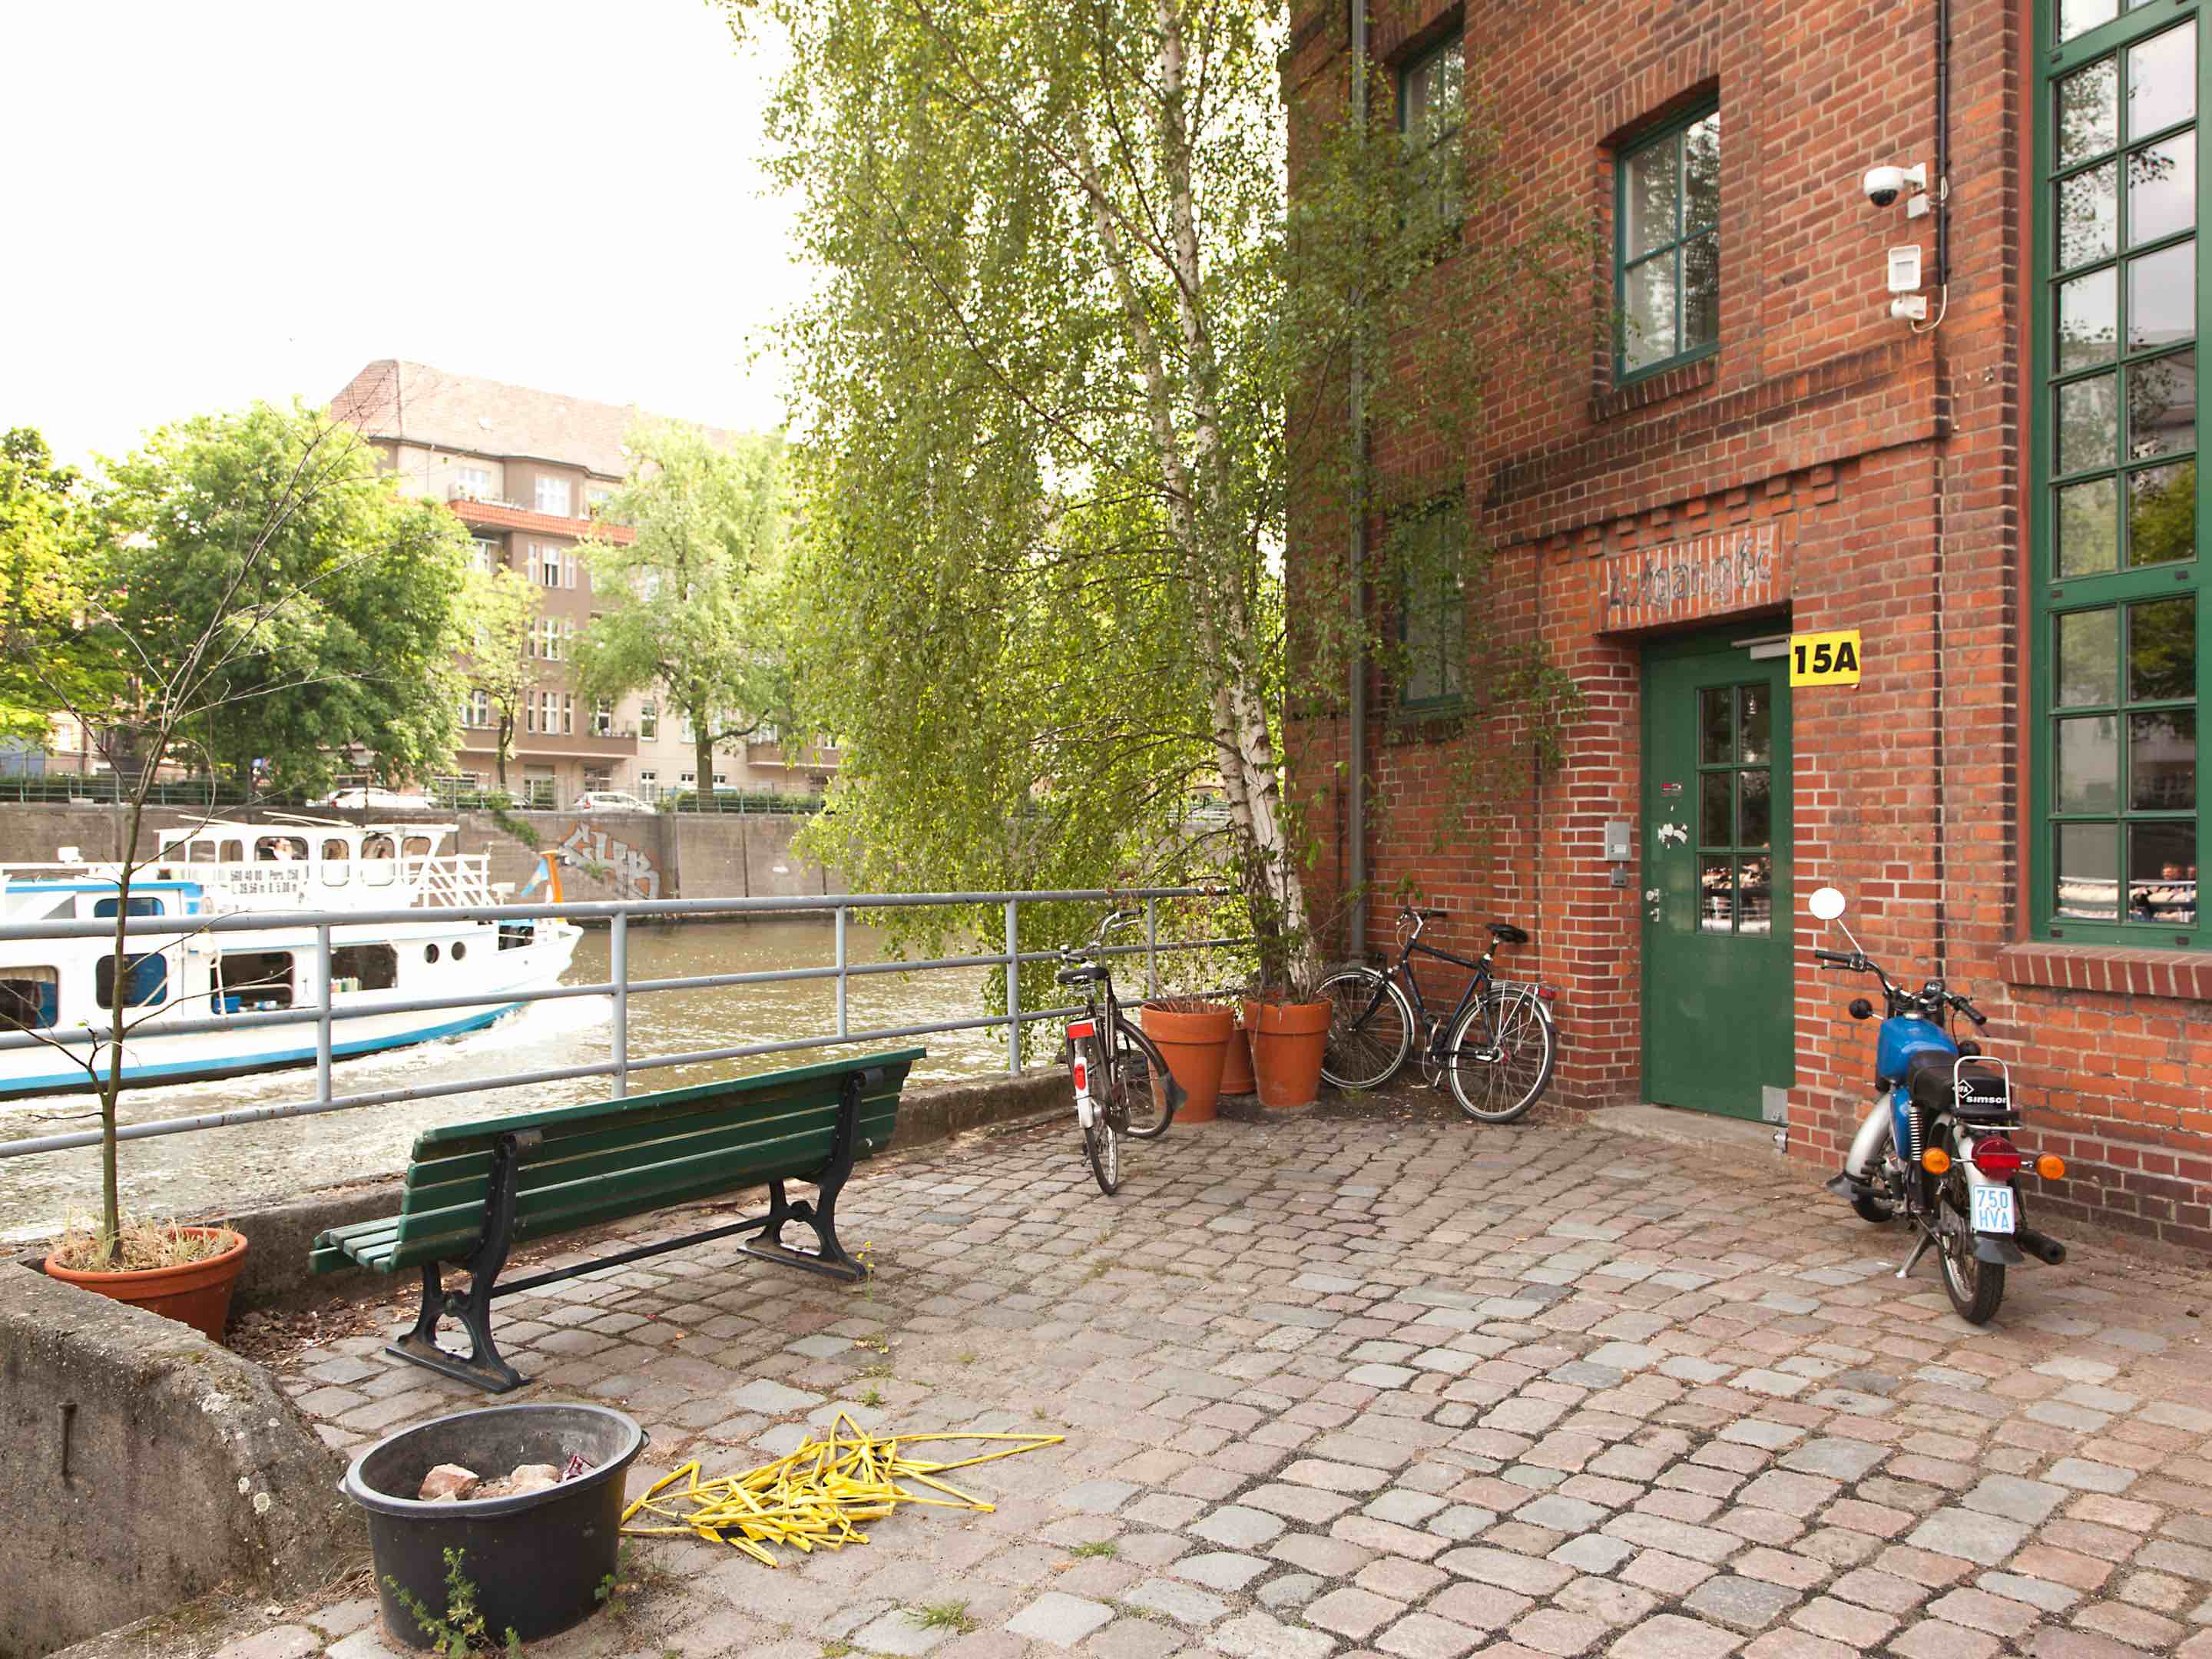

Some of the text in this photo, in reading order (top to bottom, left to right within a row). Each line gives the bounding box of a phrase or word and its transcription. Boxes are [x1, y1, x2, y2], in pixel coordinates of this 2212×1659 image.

[1795, 642, 1858, 674] 15A
[1977, 1190, 2008, 1209] 750
[1979, 1210, 2010, 1229] HVA
